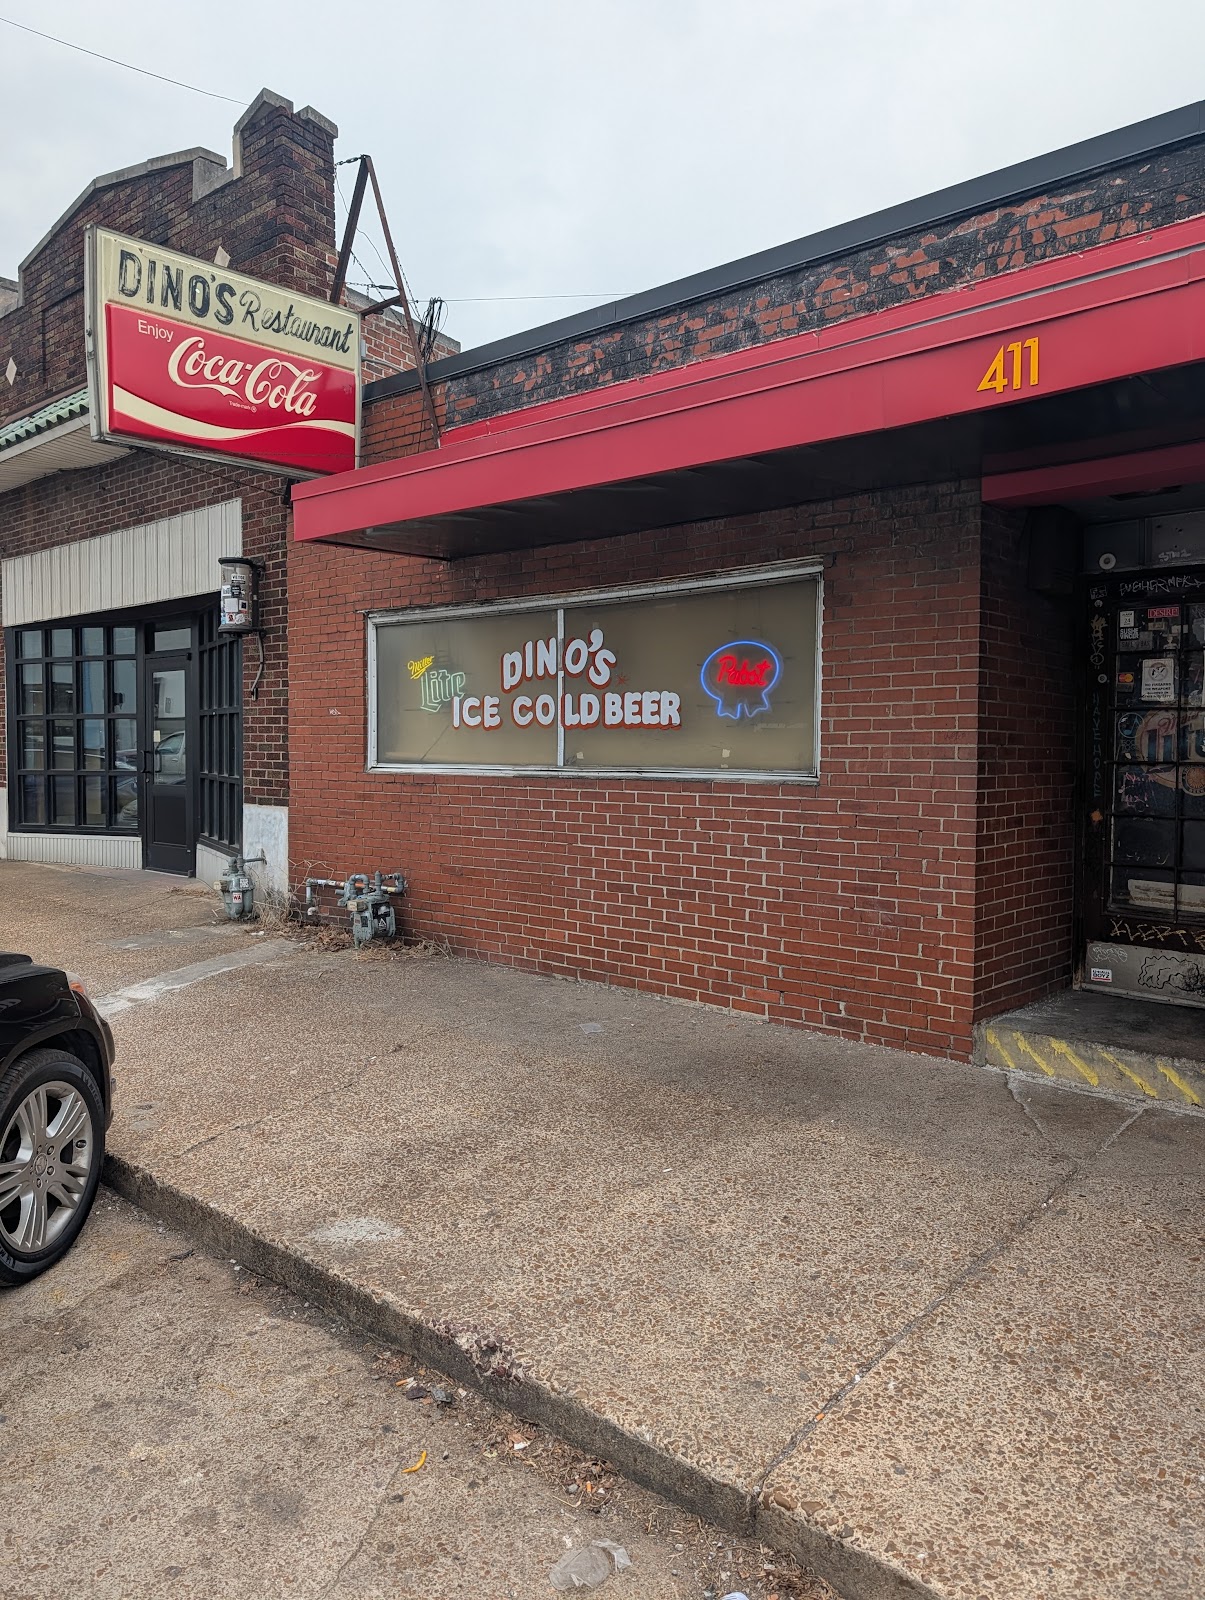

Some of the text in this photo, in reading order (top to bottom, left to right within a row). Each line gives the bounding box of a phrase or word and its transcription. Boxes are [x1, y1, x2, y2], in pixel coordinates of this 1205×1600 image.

[118, 249, 354, 354] DINO'S Restaurant
[137, 319, 174, 343] Enjoy
[168, 336, 323, 417] Coca-Cola
[976, 336, 1039, 394] 411
[408, 655, 434, 677] Miller
[501, 628, 617, 693] DINO'S
[717, 654, 772, 687] Pabst
[420, 670, 466, 713] Lite
[452, 690, 682, 731] ICE COLD BEER
